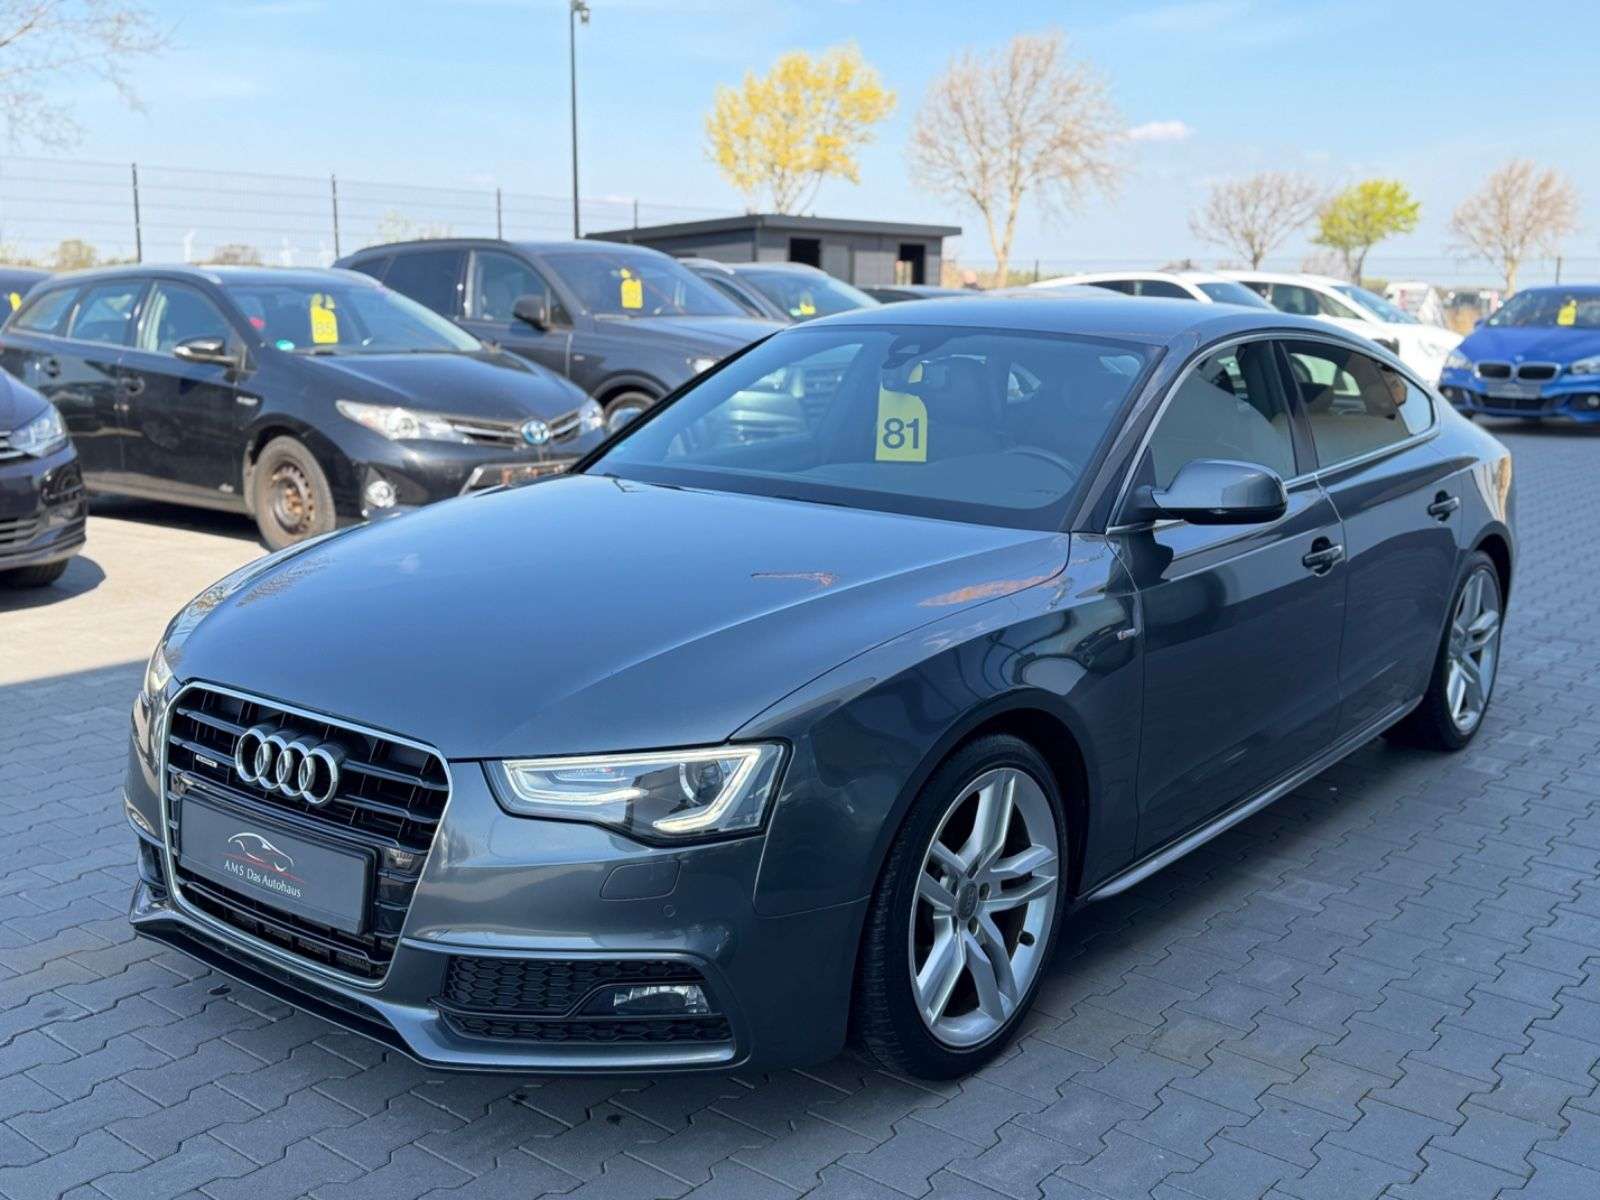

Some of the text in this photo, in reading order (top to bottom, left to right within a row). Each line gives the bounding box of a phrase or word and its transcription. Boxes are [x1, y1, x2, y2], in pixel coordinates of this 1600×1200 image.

[883, 417, 920, 449] 81
[224, 860, 301, 898] AMS Das Autohaus
